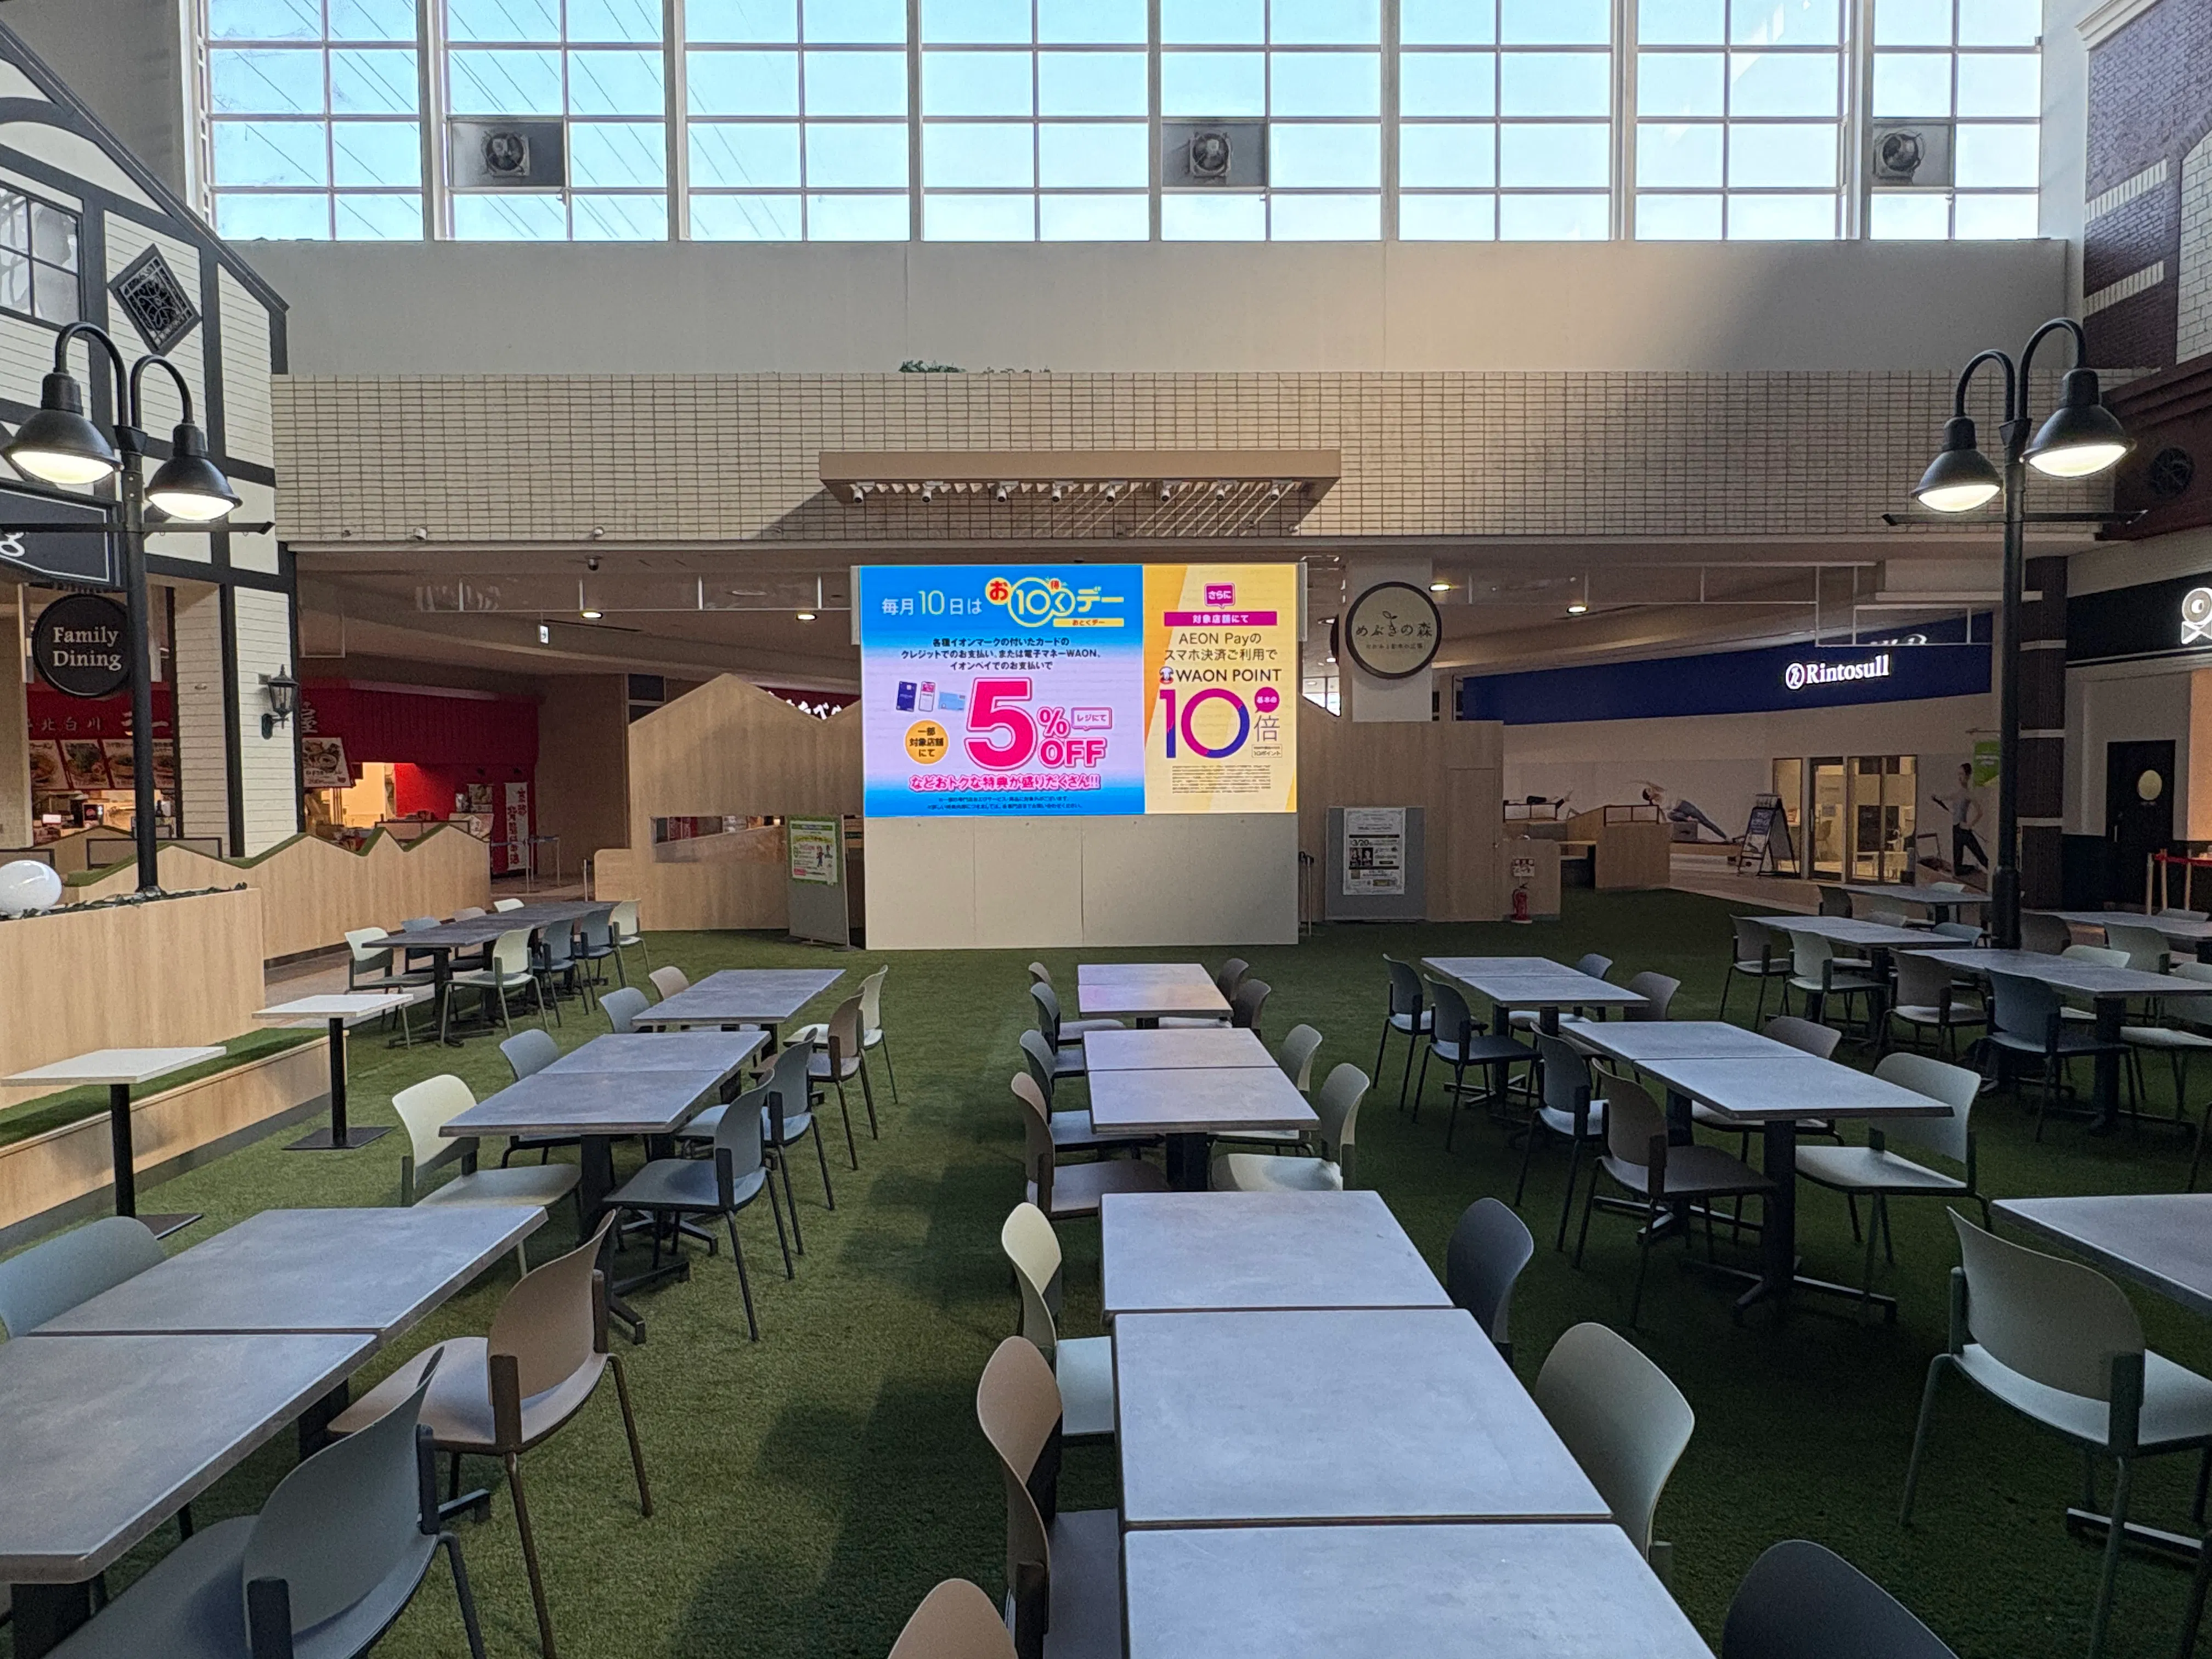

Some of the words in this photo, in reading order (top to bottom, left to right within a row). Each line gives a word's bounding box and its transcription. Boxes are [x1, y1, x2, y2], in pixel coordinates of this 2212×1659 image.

[1207, 590, 1232, 600] さらに
[882, 590, 983, 616] 毎月10日は
[1192, 614, 1249, 624] 対象店舗にて
[1356, 622, 1432, 638] めぶきの森
[53, 626, 119, 647] Family
[933, 637, 1070, 647] 各種イオンマークの付いたカードの
[1179, 633, 1219, 645] AEON
[1164, 648, 1278, 661] スマホ決済ご利用で
[53, 650, 122, 672] Dining
[950, 661, 1053, 670] イオンペイでのお支払いで
[1806, 654, 1889, 684] Rintosull
[1176, 669, 1227, 682] WAON
[1233, 669, 1282, 682] POINT
[1076, 713, 1107, 723] レジにて
[917, 726, 936, 736] 一部
[918, 748, 936, 757] にて
